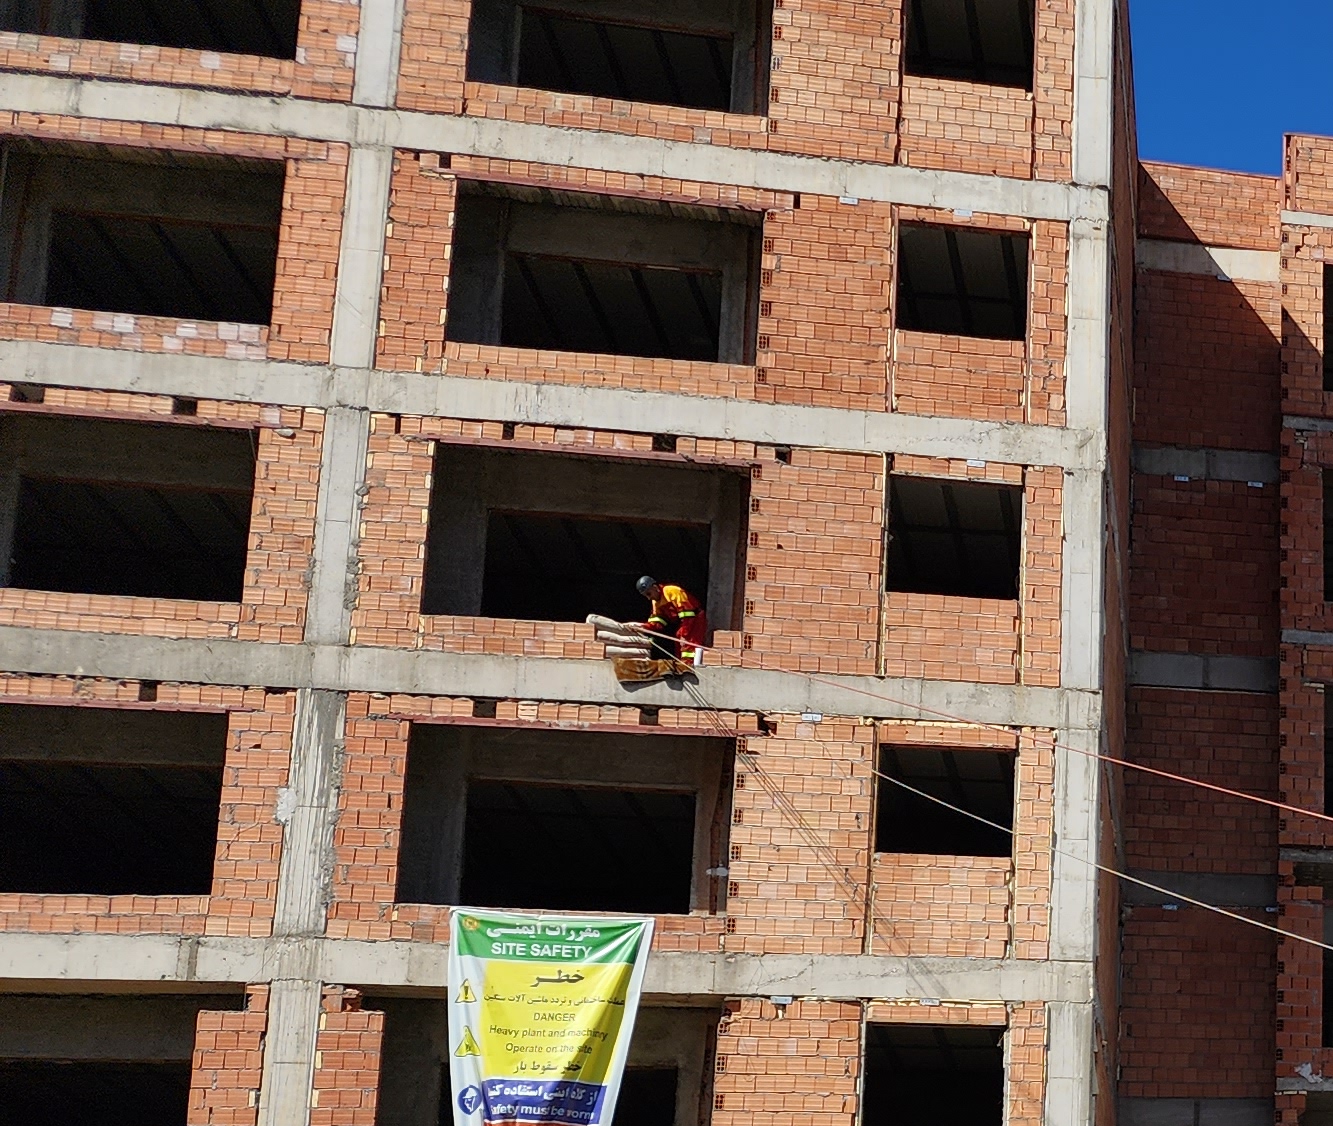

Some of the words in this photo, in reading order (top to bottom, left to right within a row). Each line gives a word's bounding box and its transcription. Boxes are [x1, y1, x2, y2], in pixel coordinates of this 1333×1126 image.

[486, 922, 541, 939] ایمنی
[545, 924, 600, 941] مقررات
[491, 943, 527, 956] SITE
[530, 944, 592, 958] SAFETY
[530, 969, 585, 987] خطر
[533, 1012, 576, 1022] DANGER
[489, 1025, 519, 1038] Heavy
[521, 1027, 546, 1041] plant
[548, 1028, 566, 1037] and
[505, 1042, 543, 1054] Operate
[546, 1045, 557, 1053] on
[560, 1044, 574, 1053] the
[513, 1060, 527, 1074] بار
[530, 1060, 558, 1074] سقوط
[586, 1090, 598, 1105] از
